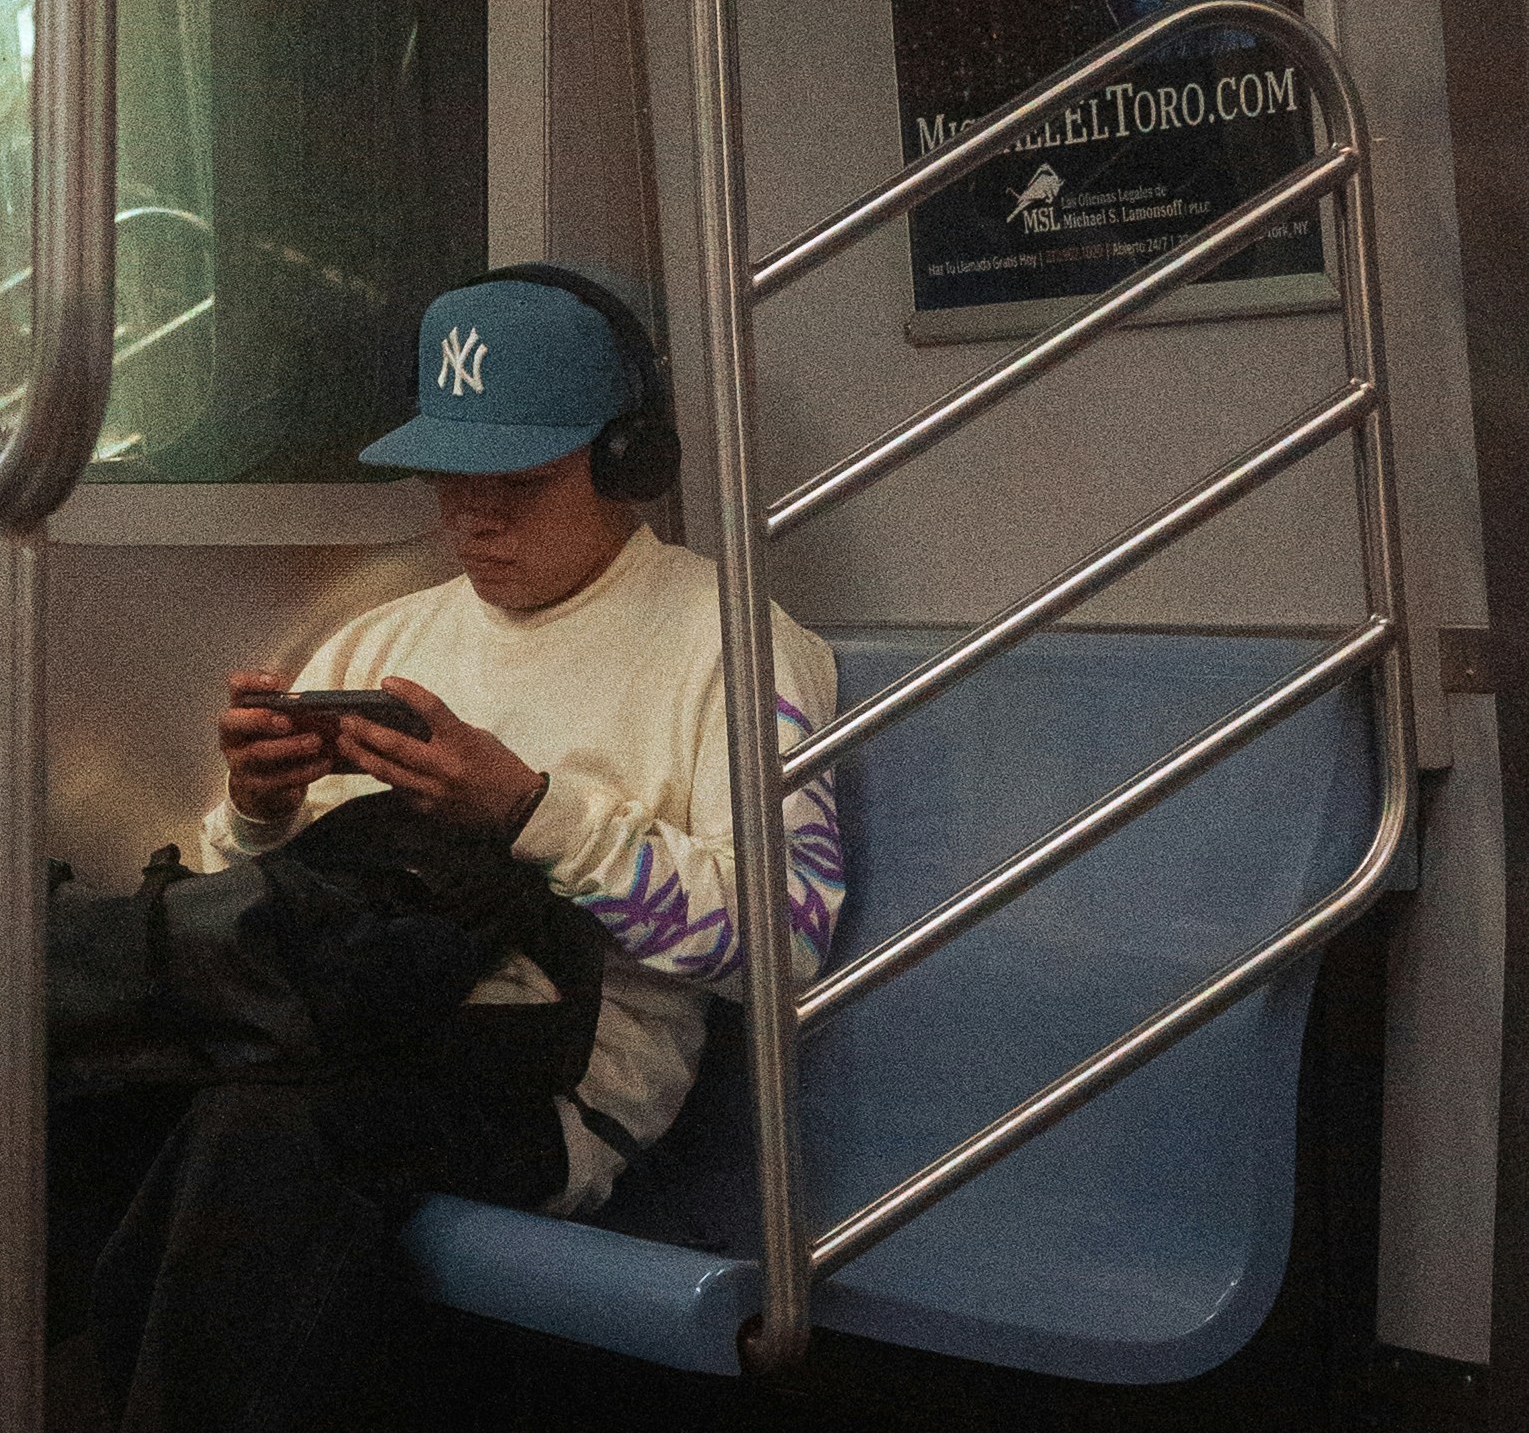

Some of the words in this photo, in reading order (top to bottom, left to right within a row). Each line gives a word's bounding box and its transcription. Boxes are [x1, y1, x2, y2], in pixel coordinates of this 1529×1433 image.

[1118, 185, 1153, 203] Legales
[1023, 205, 1061, 234] MSL
[1063, 208, 1106, 229] Michael
[1108, 207, 1120, 224] S.
[1121, 198, 1183, 223] Lamonsoff
